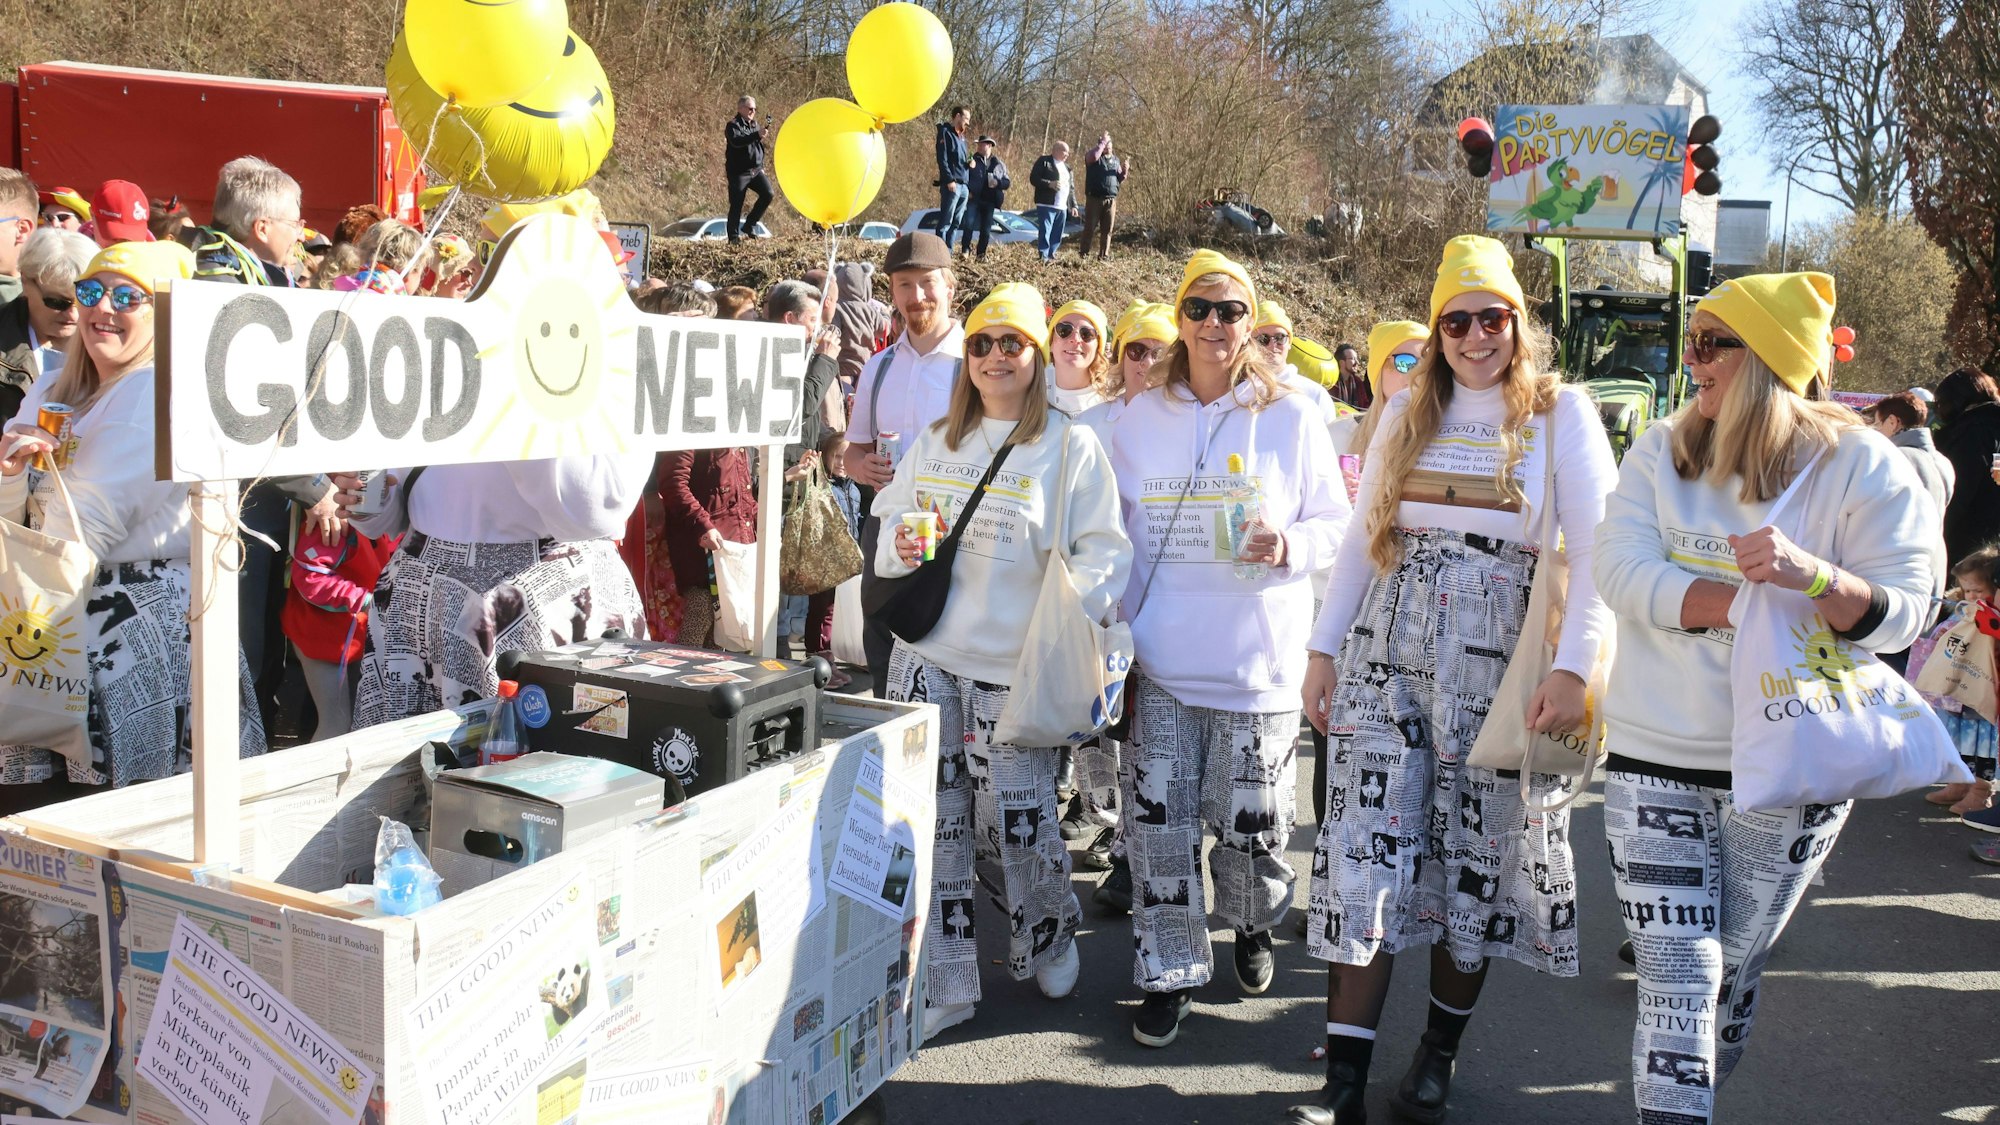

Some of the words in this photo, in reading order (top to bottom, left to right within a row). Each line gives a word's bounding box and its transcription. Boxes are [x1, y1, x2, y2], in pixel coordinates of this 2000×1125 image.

[1515, 111, 1557, 137] Die
[1498, 120, 1682, 176] PARTYVÖGEL
[1619, 297, 1647, 305] AXOS
[205, 292, 482, 447] GOOD
[634, 325, 801, 437] NEWS
[58, 416, 72, 442] city
[1438, 425, 1476, 435] GOOD
[1480, 428, 1499, 437] NE
[1437, 451, 1472, 462] Strände
[1473, 455, 1483, 463] in
[1448, 463, 1470, 472] jetzt
[924, 463, 943, 472] THE
[945, 465, 980, 479] GOOD
[992, 474, 1017, 485] EWS
[1143, 480, 1165, 491] THE
[954, 497, 1021, 518] Sestbestim-
[958, 539, 976, 550] raft
[972, 529, 999, 542] heute
[1001, 533, 1012, 544] in
[1148, 539, 1157, 547] in
[1175, 537, 1209, 548] künftig
[1670, 532, 1689, 547] THE
[1149, 551, 1185, 560] verboten
[418, 590, 429, 660] Optimistic
[17, 669, 88, 695] NEWS
[1760, 667, 1798, 699] Onl
[1764, 695, 1841, 722] GOOD
[1854, 684, 1906, 708] NEWS
[1147, 742, 1178, 753] FINDING
[1365, 751, 1402, 765] MORPH
[861, 762, 878, 785] THE
[1171, 760, 1179, 779] NOW
[1001, 789, 1036, 802] MORPH
[1166, 778, 1188, 789] TRUTH
[634, 793, 661, 807] amscan
[521, 811, 557, 826] amscan
[710, 868, 732, 894] THE
[737, 834, 770, 872] GOOD
[773, 806, 802, 835] NEWS
[849, 817, 877, 847] Weniger
[878, 835, 893, 857] Tier-
[842, 840, 873, 868] versuche
[873, 856, 881, 871] in
[1703, 811, 1720, 899] CAMPING
[835, 860, 880, 894] Deutschland
[937, 880, 971, 893] MORPH
[10, 884, 28, 896] Winter
[28, 890, 38, 898] hat
[70, 898, 88, 910] Seiten
[292, 923, 326, 942] Bomben
[327, 932, 343, 945] auf
[344, 936, 379, 955] Rosbach
[414, 992, 453, 1030] THE
[460, 941, 513, 993] GOOD
[519, 897, 564, 944] NEWS
[181, 932, 217, 974] THE
[222, 969, 279, 1024] GOOD
[284, 1021, 339, 1075] NEWS
[1638, 990, 1717, 1014] POPULAR
[170, 988, 227, 1045] Verkauf
[228, 1040, 252, 1071] von
[174, 974, 203, 1003] Betroffen
[203, 1000, 213, 1012] ist
[213, 1008, 227, 1023] zum
[227, 1018, 251, 1044] Beispiel
[251, 1041, 283, 1074] Spielzeug
[283, 1069, 296, 1084] und
[606, 1012, 641, 1040] gesucht!
[1637, 1011, 1716, 1035] ACTIVITY
[162, 1010, 252, 1097] Mikroplastik
[376, 1055, 385, 1066] zu
[435, 1043, 489, 1101] Immer
[494, 1005, 533, 1047] mehr
[156, 1031, 172, 1053] in
[174, 1046, 199, 1075] EU
[199, 1070, 251, 1125] künftig
[494, 1033, 564, 1103] Wildbahn
[150, 1055, 209, 1114] verboten
[441, 1068, 500, 1125] Pandas
[503, 1048, 519, 1067] in
[588, 1084, 615, 1103] THE
[619, 1077, 660, 1097] GOOD
[663, 1069, 696, 1090] NEWS
